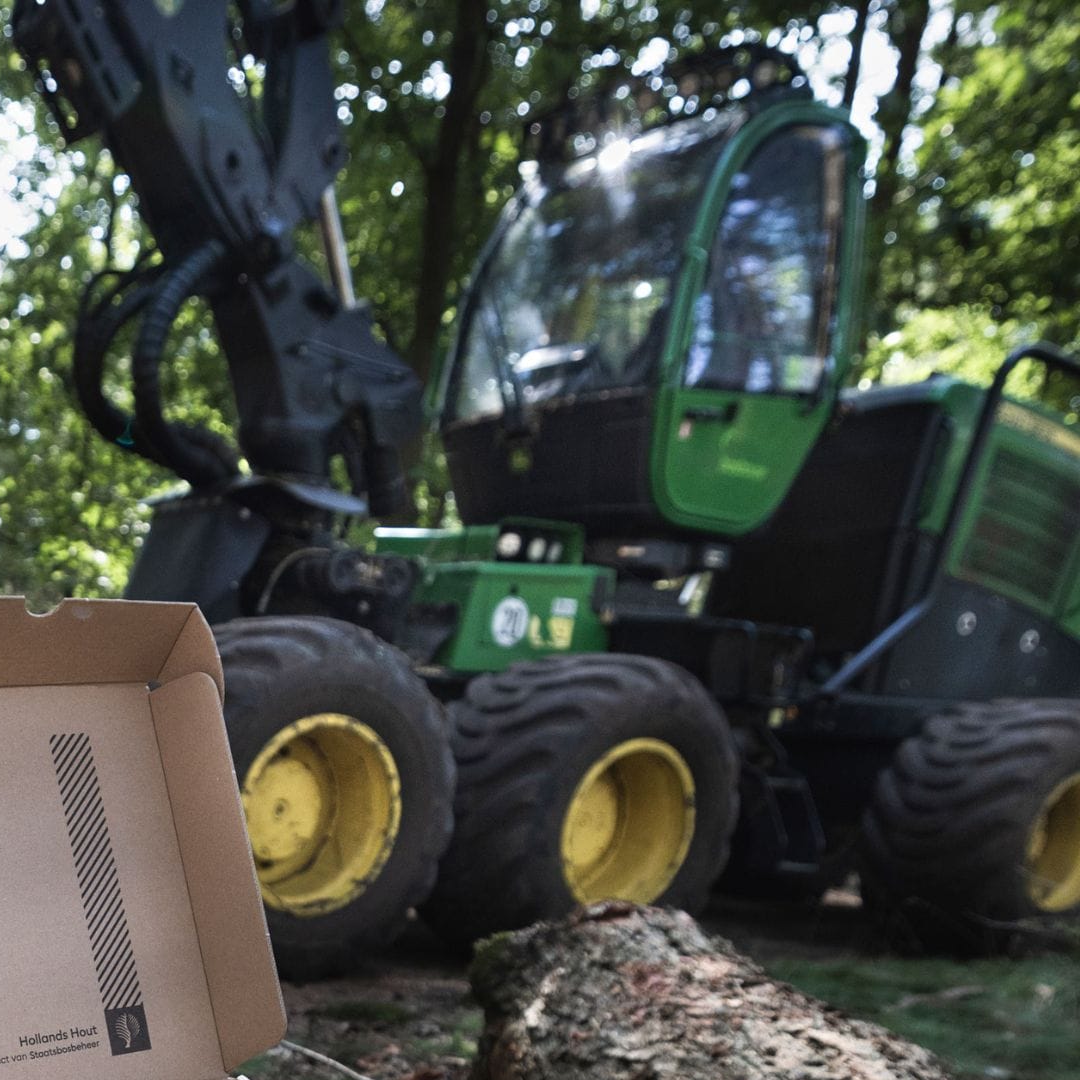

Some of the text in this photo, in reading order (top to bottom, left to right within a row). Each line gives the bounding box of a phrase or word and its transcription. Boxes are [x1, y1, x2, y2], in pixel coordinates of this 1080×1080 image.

[19, 1025, 98, 1047] Hollands Hout
[10, 1053, 27, 1062] van
[29, 1041, 99, 1059] Staatsbosbeheer
